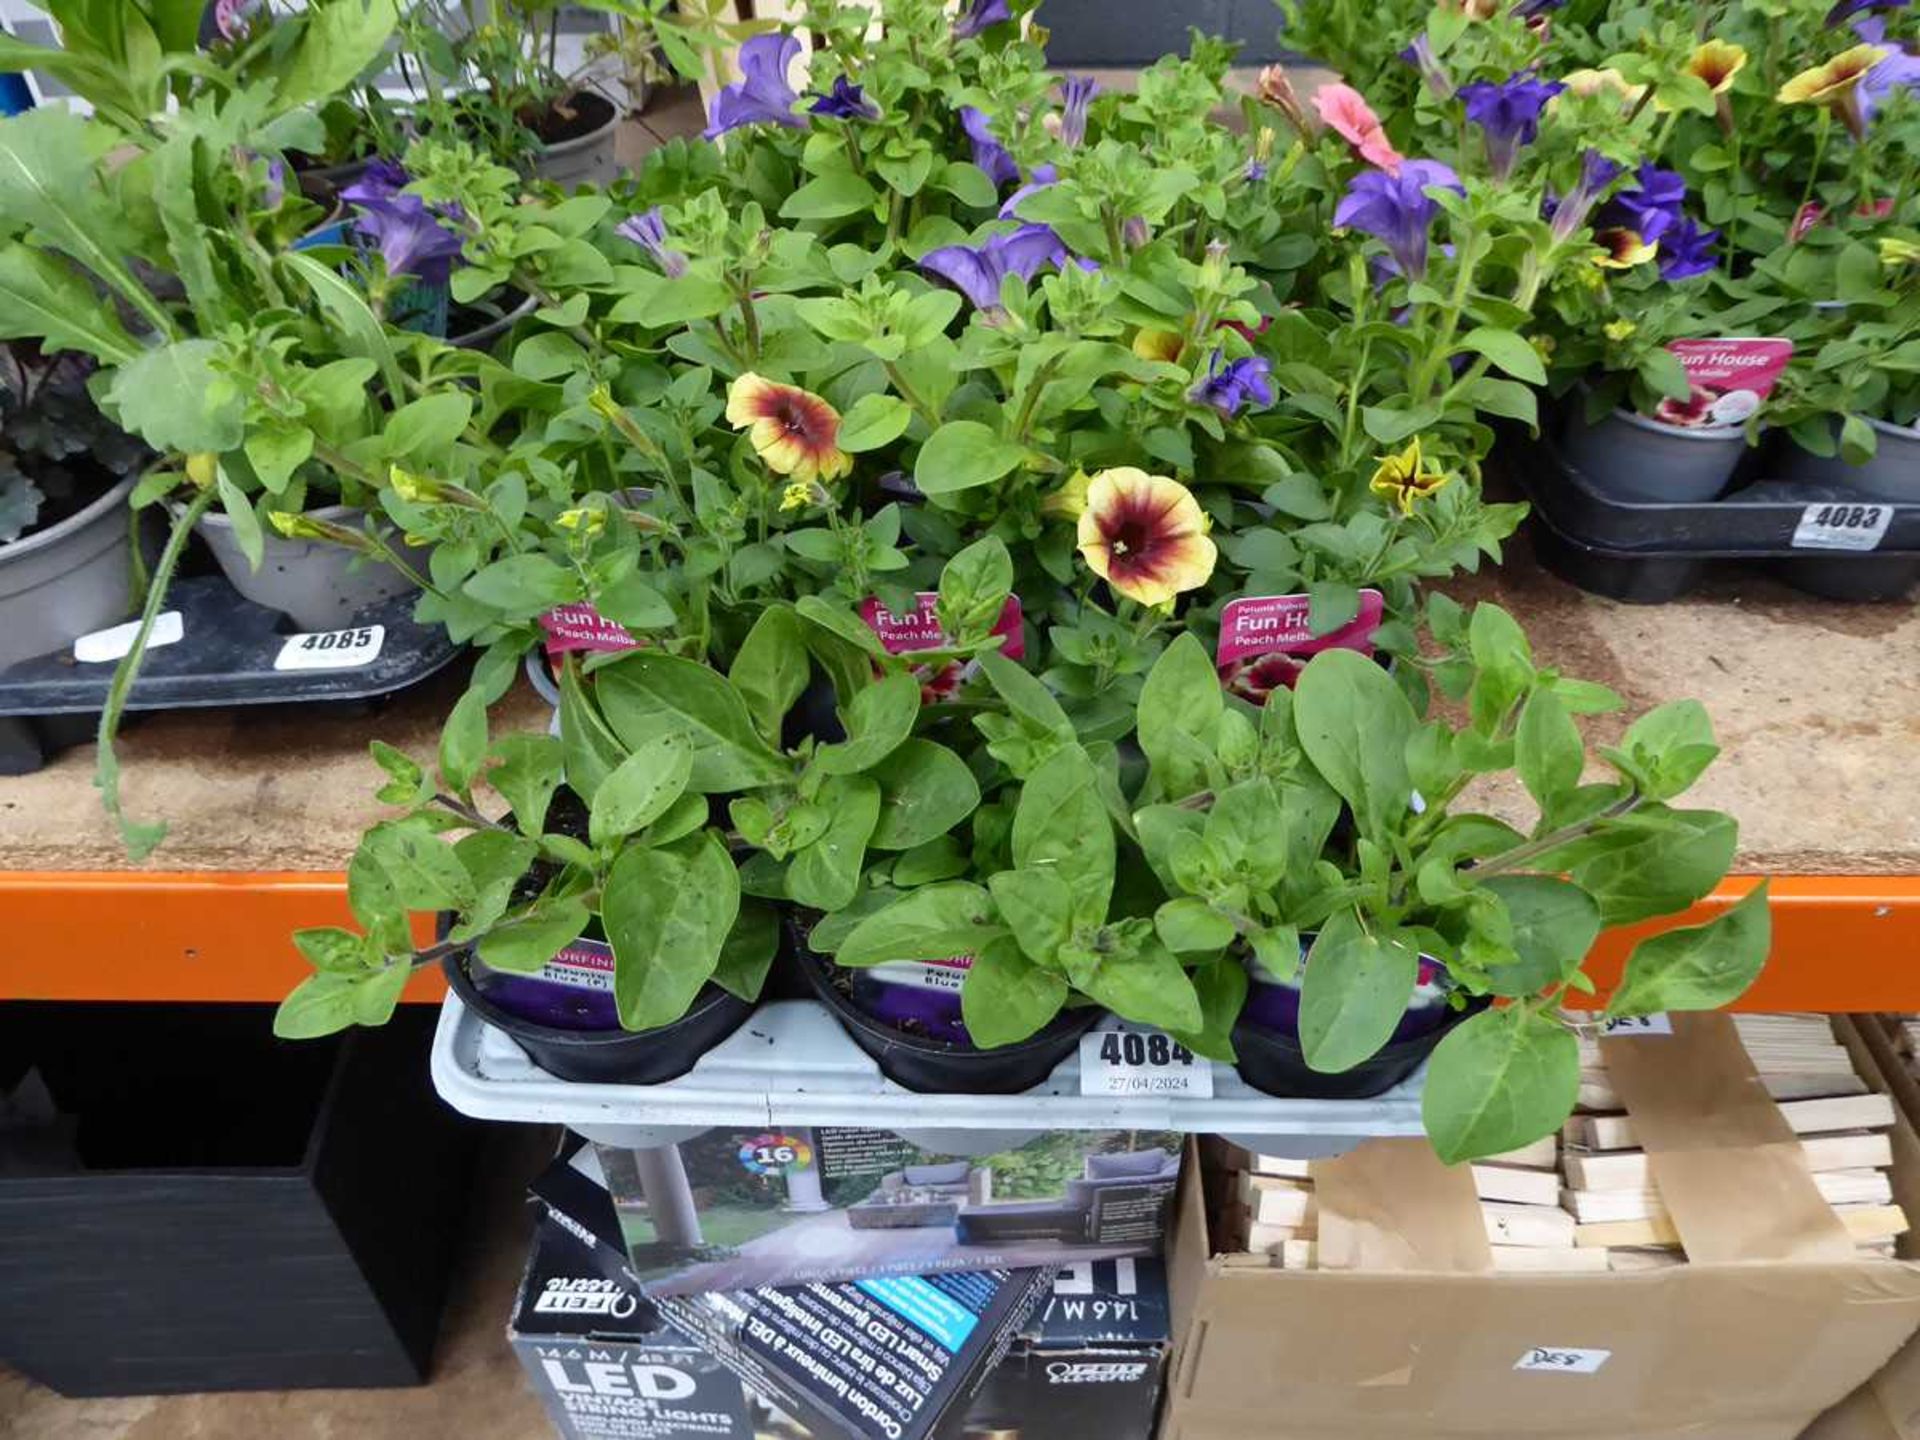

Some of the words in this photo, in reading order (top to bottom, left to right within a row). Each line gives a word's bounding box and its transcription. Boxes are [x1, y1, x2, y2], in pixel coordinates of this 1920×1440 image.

[1708, 352, 1771, 366] House
[1815, 506, 1882, 528] 4083
[552, 607, 593, 626] Fun
[1236, 616, 1278, 631] Fun
[301, 628, 372, 650] 4085
[556, 627, 594, 641] Peach
[880, 631, 918, 640] Peach
[1235, 635, 1273, 645] Peach
[1276, 632, 1309, 643] Melb
[925, 976, 959, 988] Blue
[927, 967, 966, 980] Petu
[1100, 1033, 1194, 1066] 4084
[1108, 1077, 1189, 1090] 27/04/2024
[755, 1146, 795, 1164] 16
[542, 1295, 609, 1311] FEIT
[1063, 1301, 1084, 1320] M
[1094, 1299, 1138, 1320] 14.6
[743, 1315, 777, 1345] DEL
[865, 1318, 899, 1349] LED
[769, 1334, 787, 1353] à
[817, 1325, 853, 1356] LED
[589, 1349, 611, 1361] M
[846, 1346, 877, 1374] tira
[893, 1339, 944, 1382] Smart
[541, 1358, 697, 1400] LED
[780, 1342, 850, 1398] lumineux
[870, 1363, 897, 1388] de
[557, 1392, 660, 1409] VINTAGE
[890, 1379, 925, 1410] Luz
[654, 1409, 734, 1425] LIGHTS
[842, 1387, 906, 1440] Cordon
